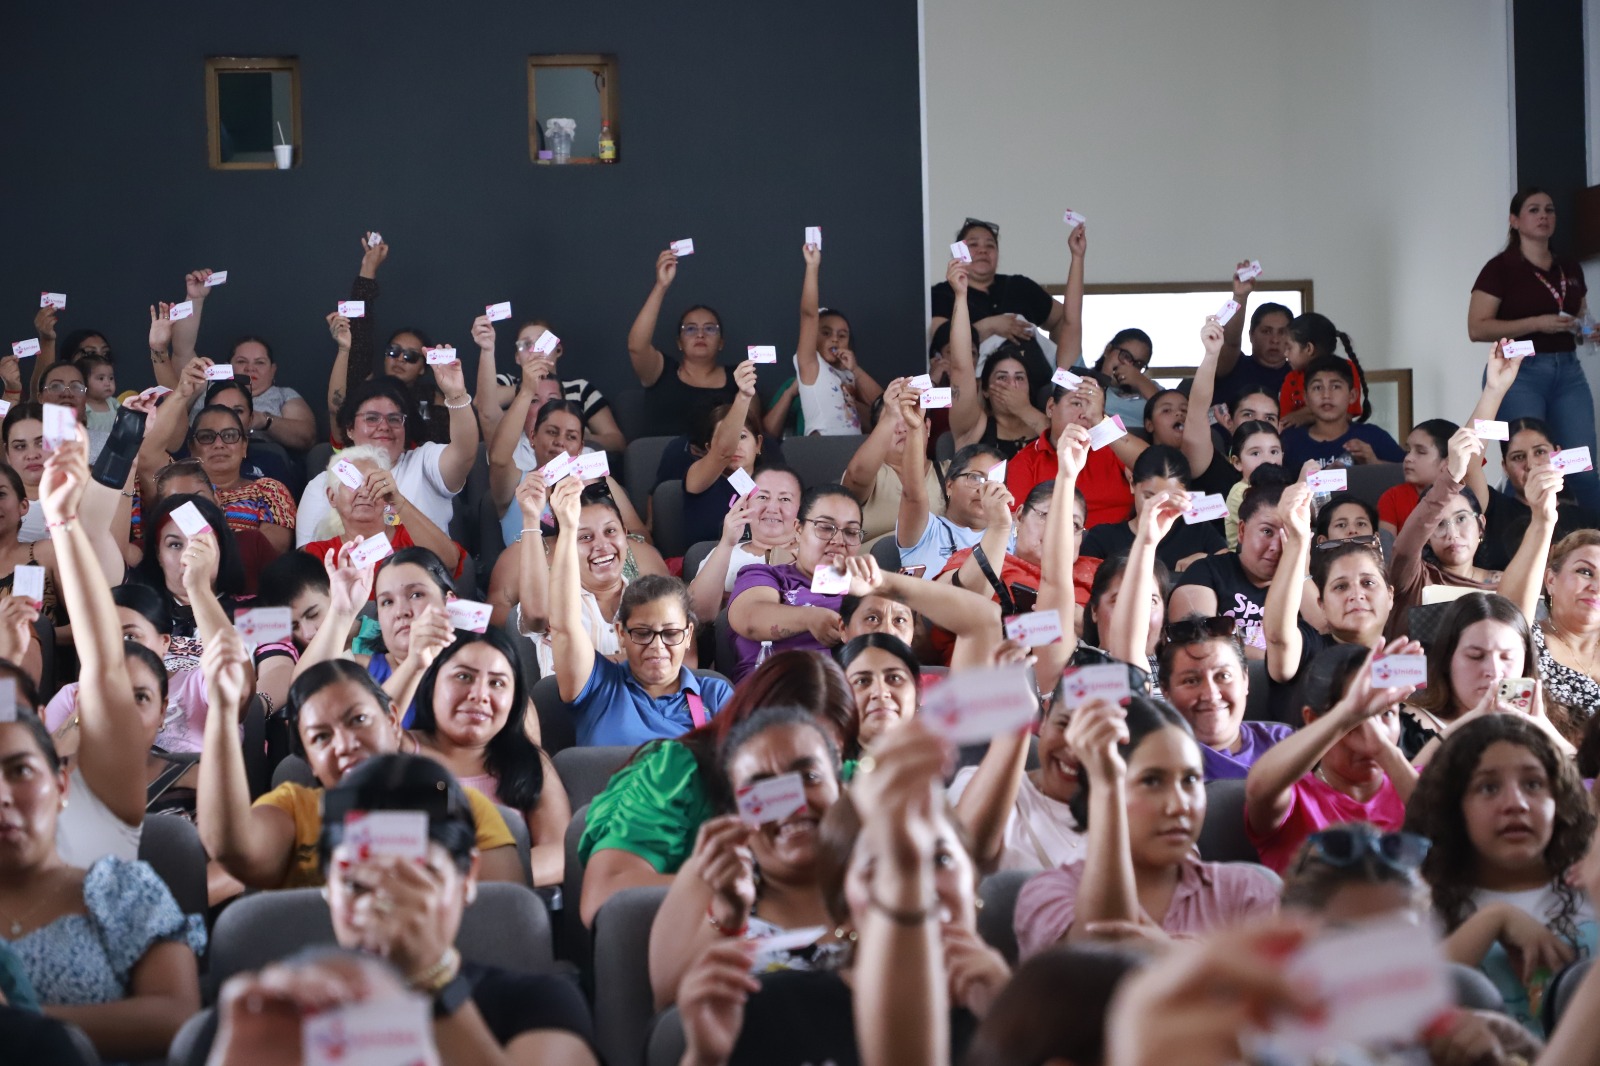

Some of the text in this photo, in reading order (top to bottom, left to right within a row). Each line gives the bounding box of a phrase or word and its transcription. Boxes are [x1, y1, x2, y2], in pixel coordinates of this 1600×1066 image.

[1566, 456, 1588, 465] Unidas
[366, 542, 387, 554] Unidas
[1029, 625, 1057, 634] Unidas
[1394, 668, 1422, 676] Unidas
